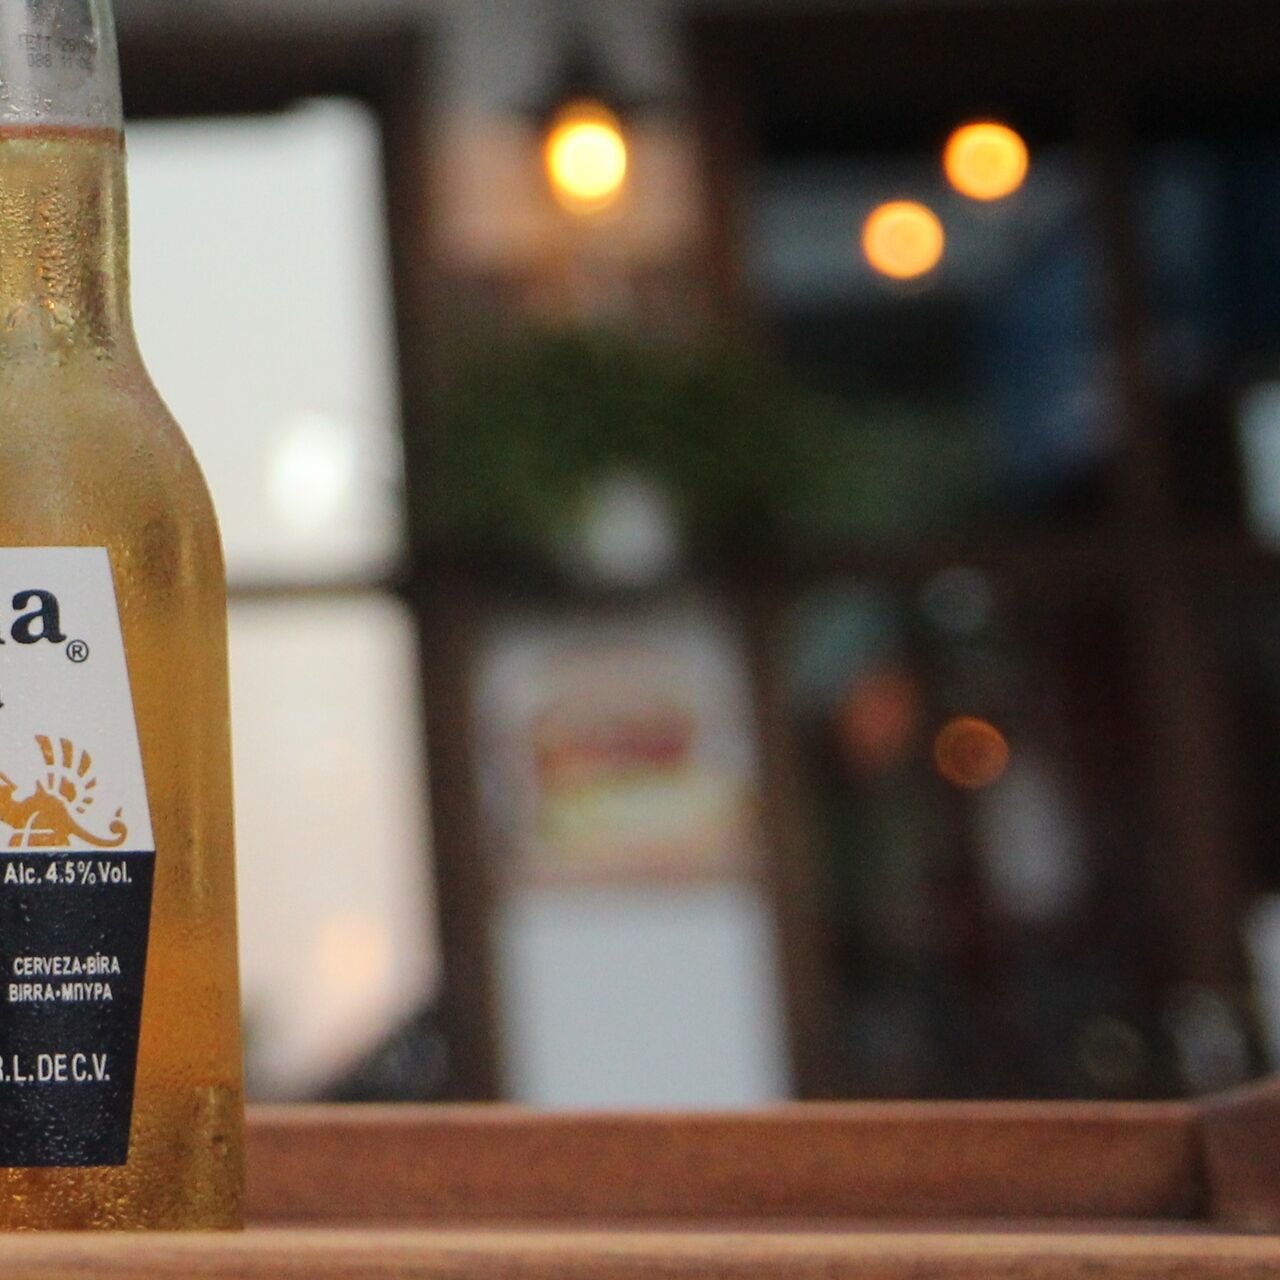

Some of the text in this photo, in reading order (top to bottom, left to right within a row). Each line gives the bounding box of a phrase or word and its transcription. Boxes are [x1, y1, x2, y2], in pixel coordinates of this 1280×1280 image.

[4, 860, 132, 885] Alc. 4.5% Vol.
